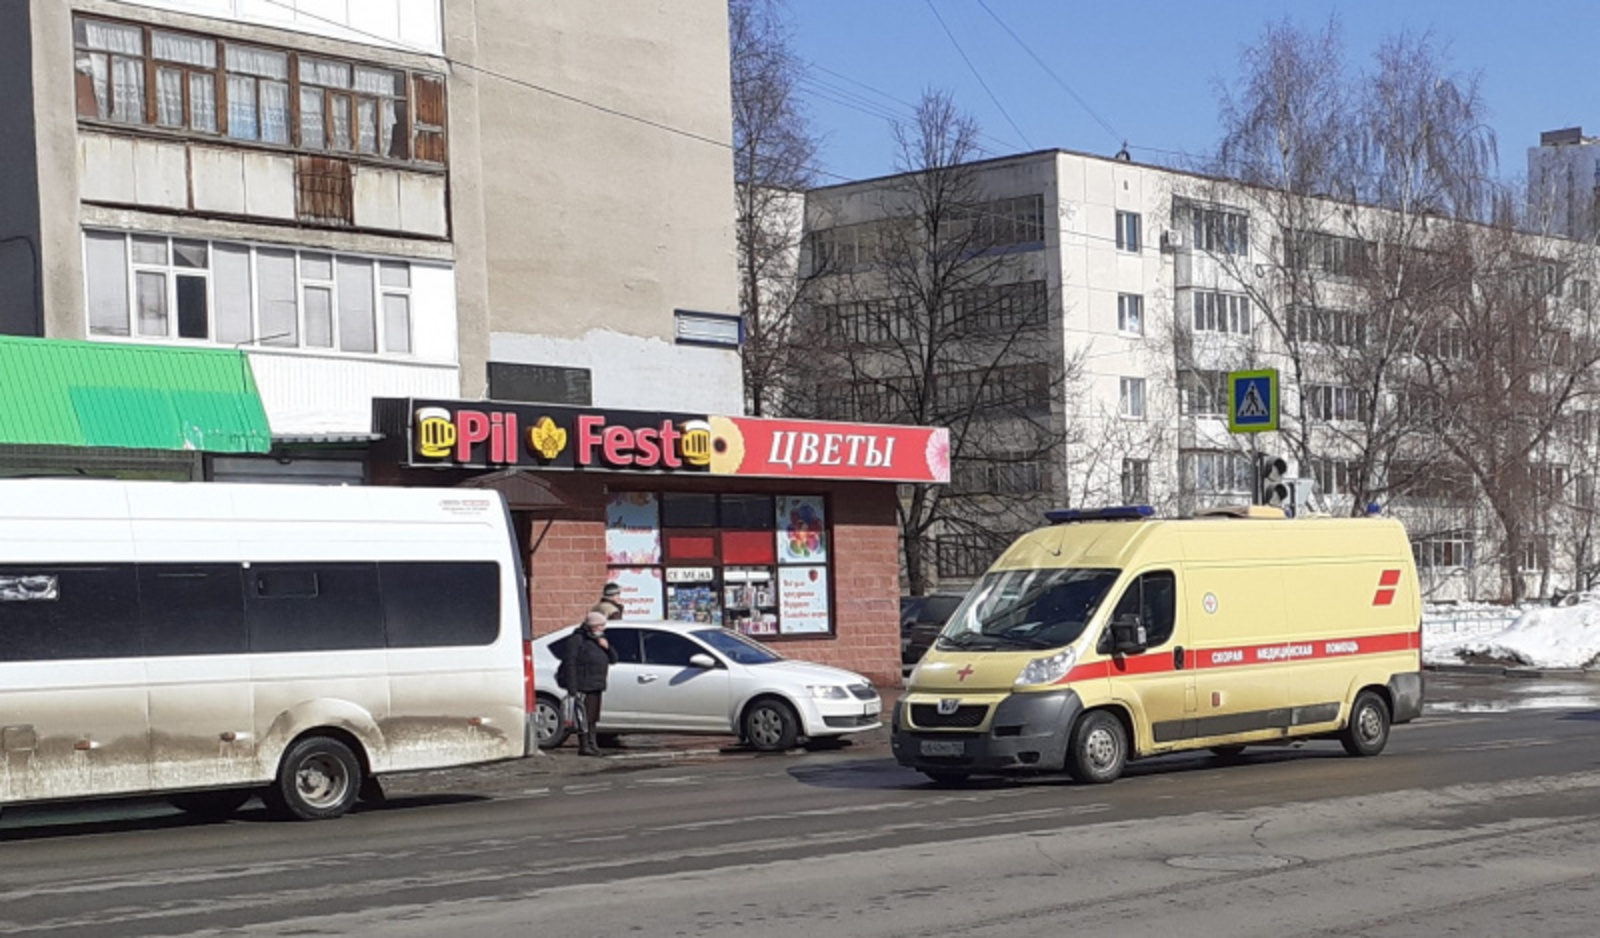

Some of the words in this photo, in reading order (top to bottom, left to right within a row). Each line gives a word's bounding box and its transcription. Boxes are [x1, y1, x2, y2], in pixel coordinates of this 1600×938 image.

[457, 410, 518, 463] Pil
[578, 414, 682, 468] Fest
[767, 430, 896, 471] ЦВЕТЫ
[1211, 650, 1243, 663] СКОРАЯ
[1257, 644, 1313, 660] МЕДИЦИНСКАЯ
[1325, 641, 1359, 653] ПОМОЩЬ
